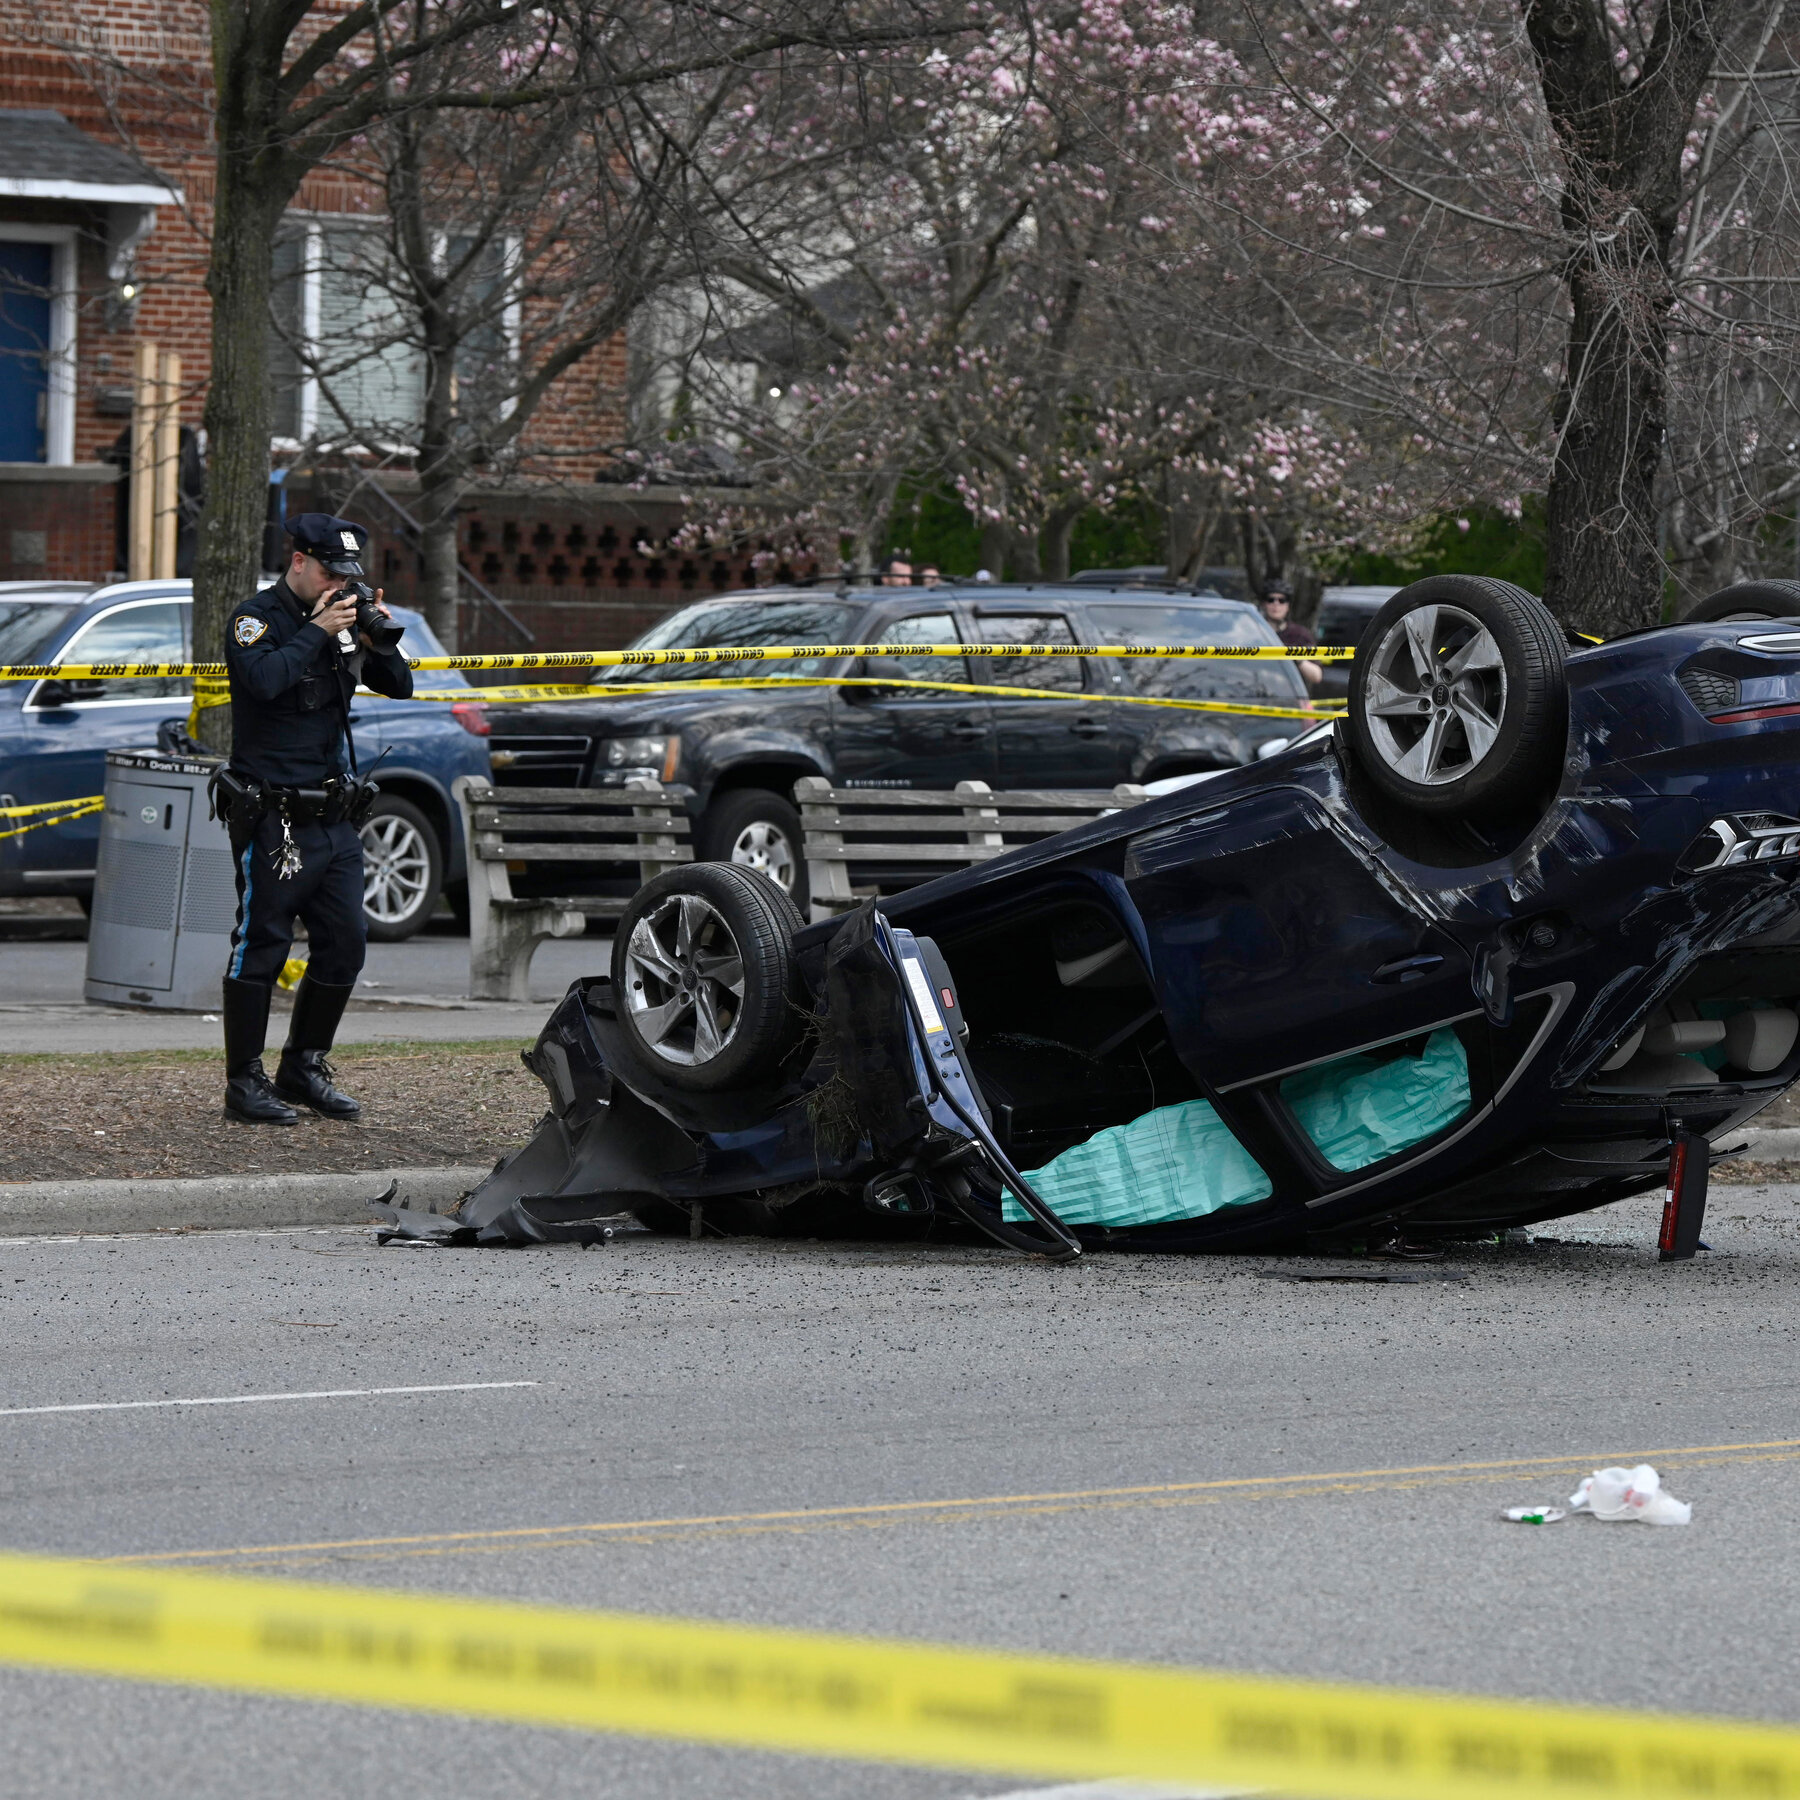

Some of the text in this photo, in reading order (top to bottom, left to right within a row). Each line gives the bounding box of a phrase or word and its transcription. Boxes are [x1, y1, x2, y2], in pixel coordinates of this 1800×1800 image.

[621, 649, 764, 664] CAUTION DO NOT ENTER
[1211, 647, 1260, 656] CAUTION
[1285, 647, 1346, 657] NOT ENTER
[448, 654, 594, 669] CAUTION DO NOT ENTER
[8, 665, 61, 676] CAUTION
[90, 664, 127, 676] ENTER
[134, 664, 160, 676] NOT
[168, 663, 184, 675] DO
[149, 760, 180, 773] Don't
